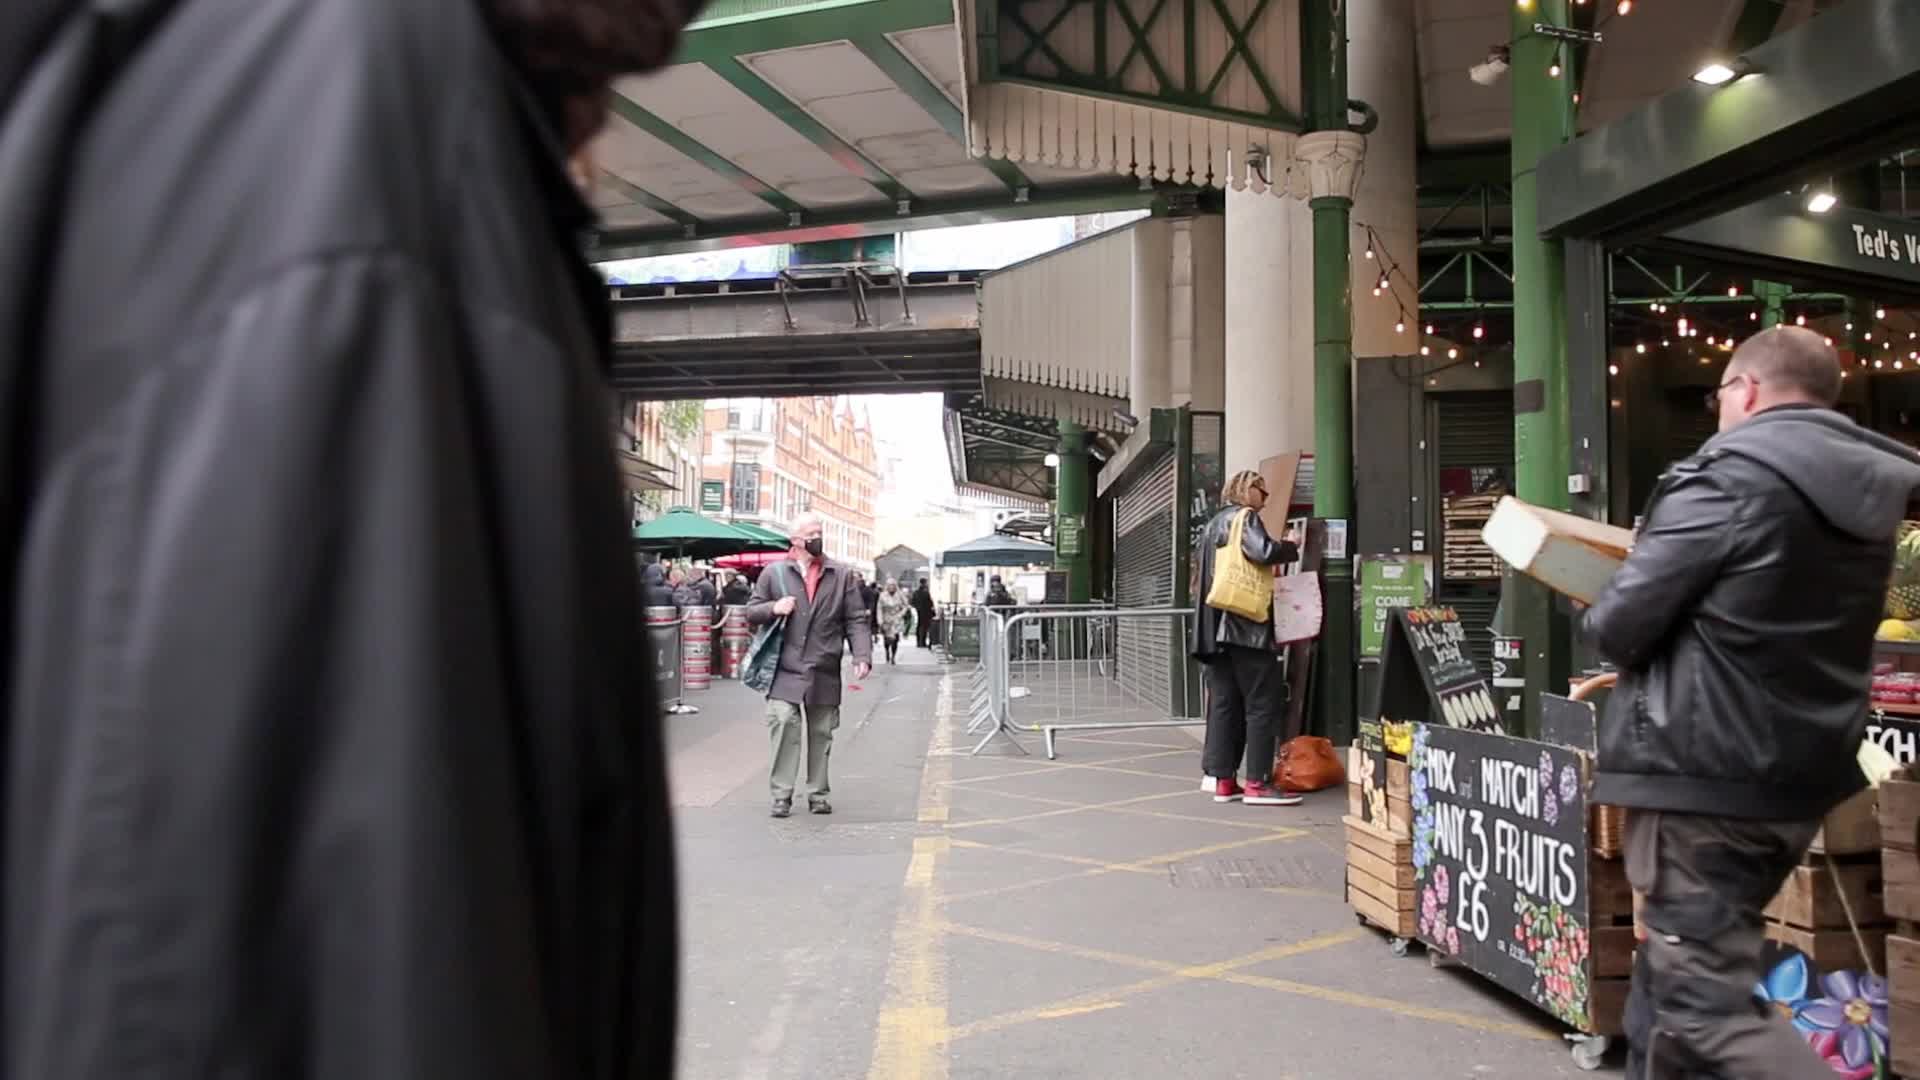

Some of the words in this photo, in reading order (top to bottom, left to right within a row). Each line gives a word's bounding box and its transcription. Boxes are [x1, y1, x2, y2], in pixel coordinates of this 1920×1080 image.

[1851, 223, 1900, 261] Ted's
[1903, 233, 1920, 265] V
[1375, 596, 1409, 608] COME
[1426, 747, 1456, 795] MIX
[1481, 757, 1539, 819] MATCH
[1434, 801, 1466, 862] ANY
[1466, 809, 1489, 881] 3
[1495, 818, 1577, 906] FRUITS
[1456, 871, 1489, 942] £6
